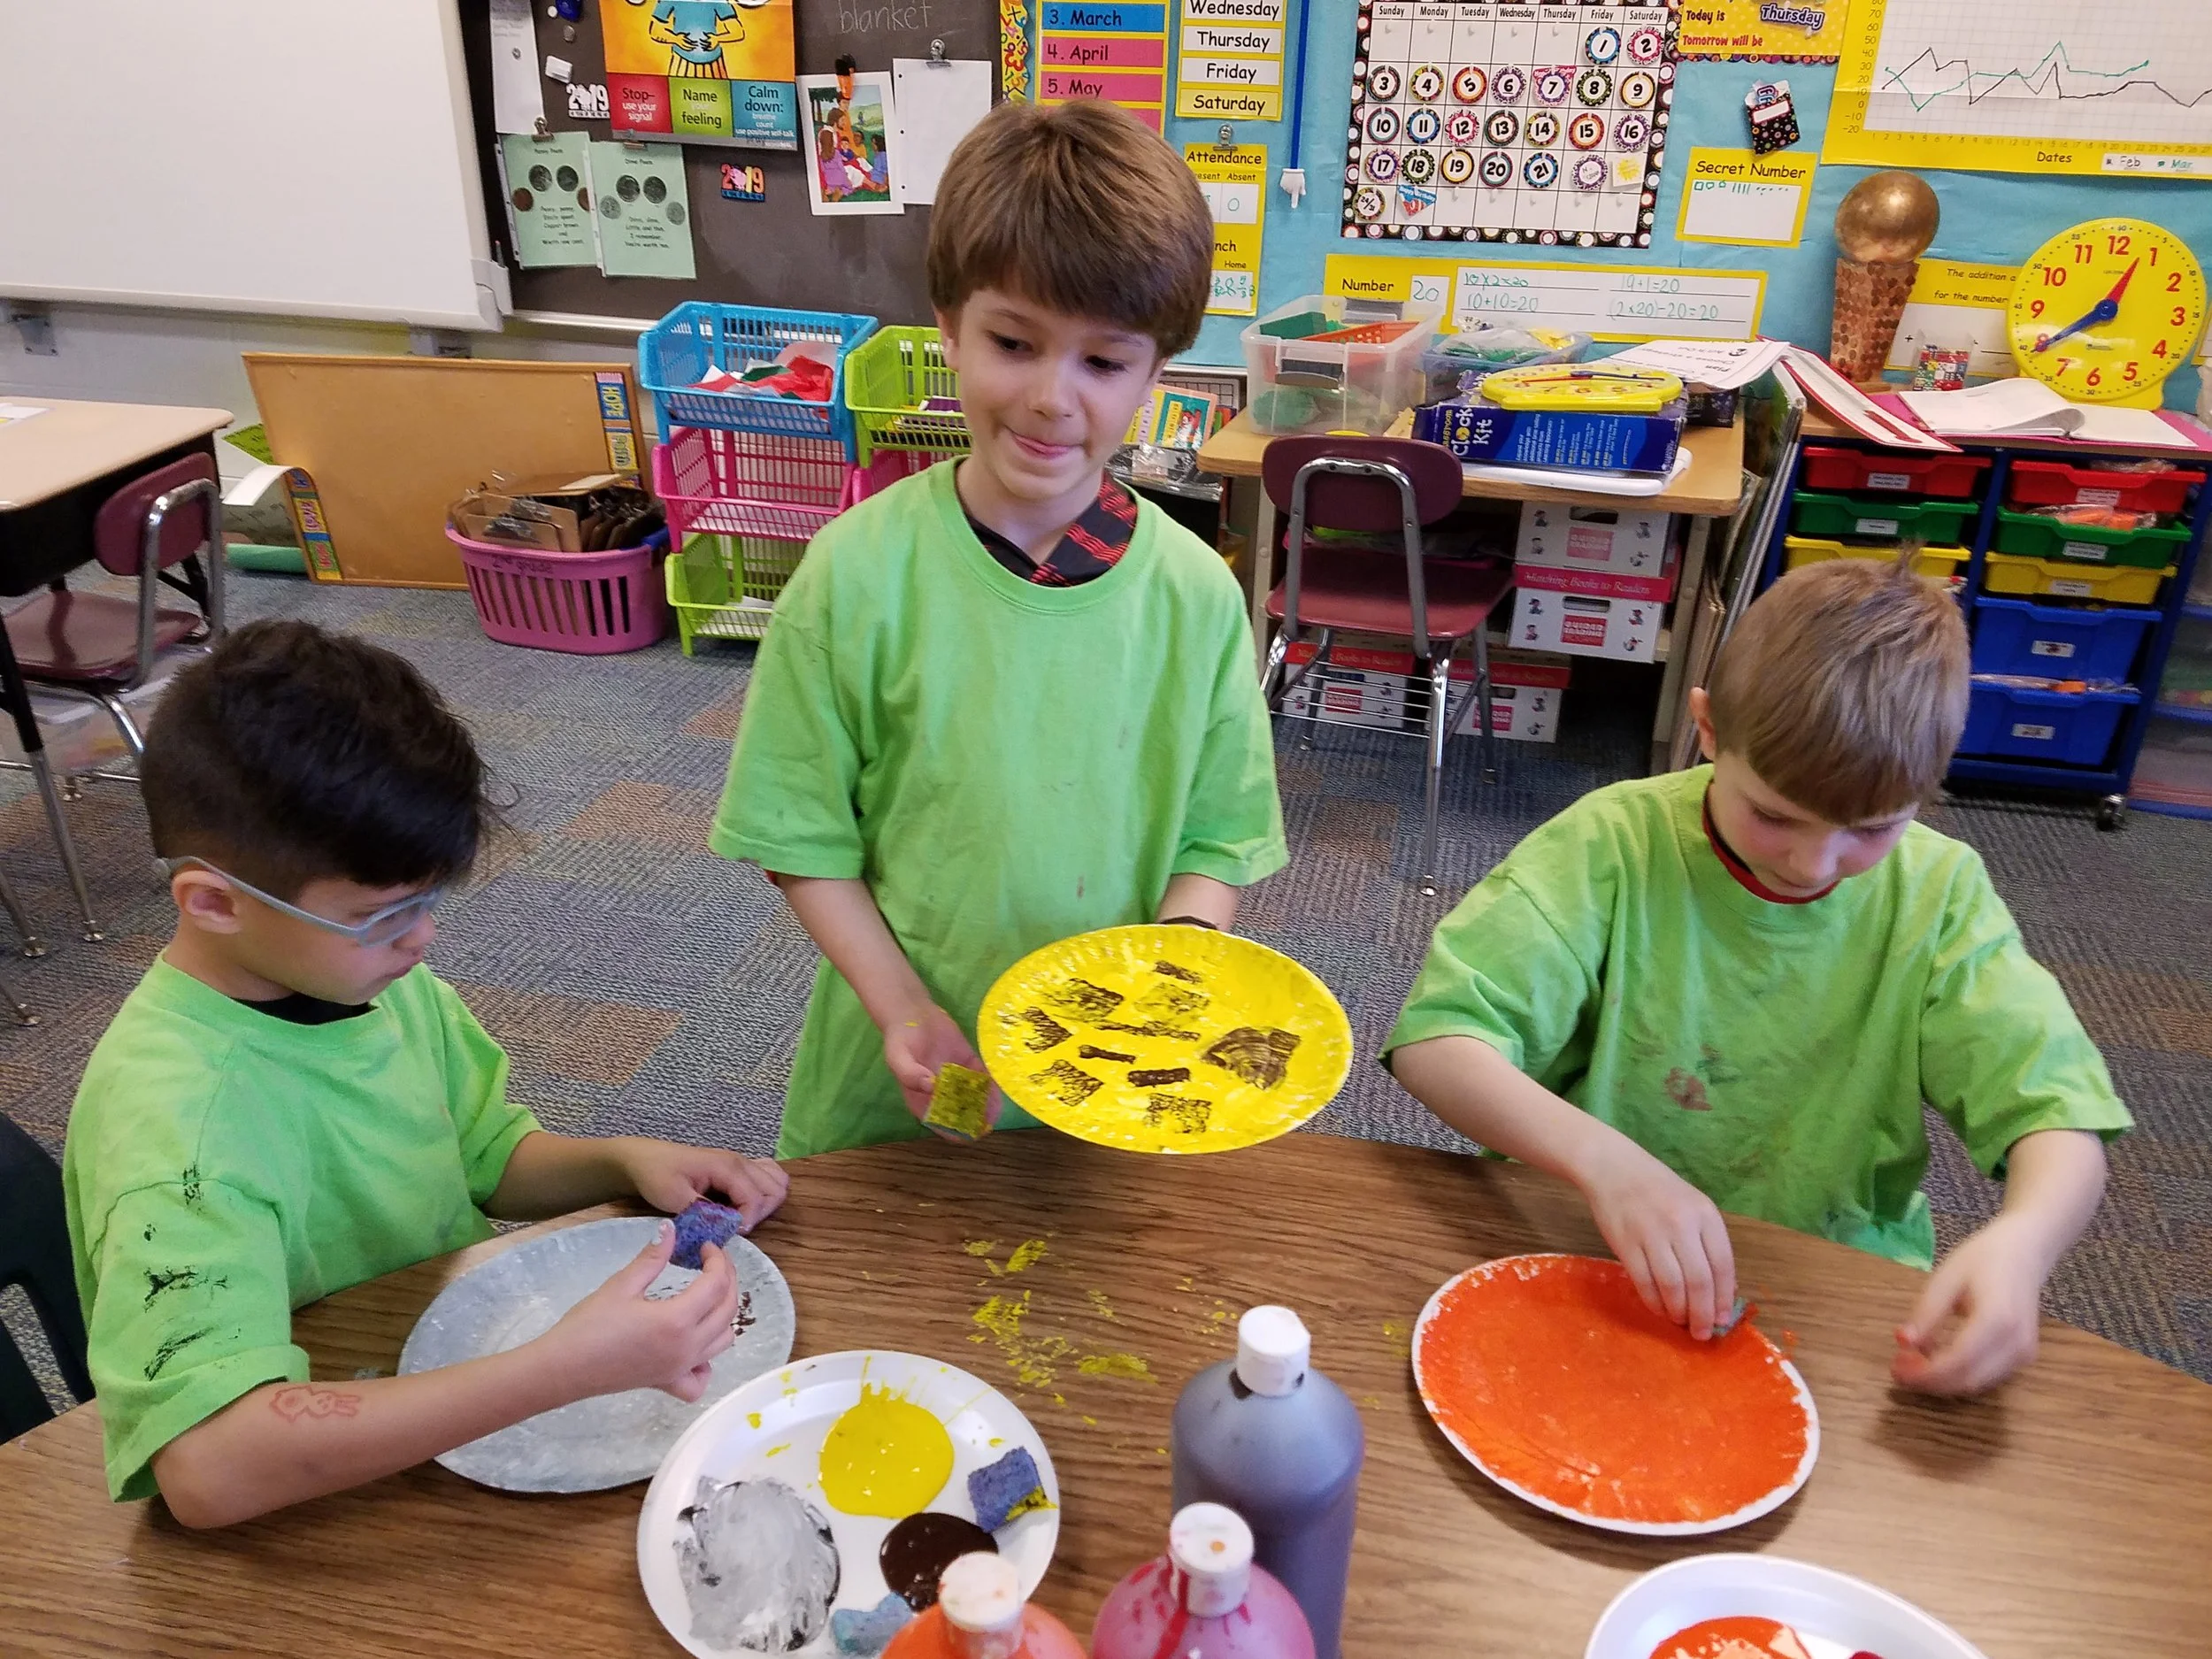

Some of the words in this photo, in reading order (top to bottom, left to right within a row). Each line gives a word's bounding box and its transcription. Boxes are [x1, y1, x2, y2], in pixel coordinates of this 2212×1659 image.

[836, 0, 933, 34] blanket
[1190, 0, 1279, 21] Wednesday
[1379, 6, 1405, 18] Sunday
[1419, 6, 1449, 19] Monday
[1461, 7, 1490, 19] Tuesday
[1499, 8, 1535, 20] Wednesday
[1543, 8, 1578, 21] Thursday
[1590, 9, 1614, 22] Friday
[1629, 10, 1663, 23] Saturday
[1686, 9, 1713, 25] Today
[1716, 10, 1724, 21] is
[1761, 4, 1825, 30] Thursday
[1048, 9, 1065, 27] 3.
[1070, 10, 1122, 27] March
[1866, 22, 1879, 31] 60
[1197, 31, 1271, 53] Thursday
[1599, 40, 1609, 53] 1
[1640, 38, 1652, 53] 2
[1682, 35, 1728, 46] Tomorrow
[1732, 35, 1749, 46] will
[1752, 35, 1763, 46] be
[1864, 35, 1877, 44] 50
[1047, 44, 1065, 61] 4.
[1069, 45, 1109, 65] April
[1862, 49, 1874, 58] 40
[1206, 64, 1257, 85] Friday
[1048, 78, 1064, 95] 5.
[1069, 79, 1102, 99] May
[1379, 76, 1389, 91] 3
[1421, 79, 1432, 92] 4
[1464, 78, 1477, 92] 5
[1503, 78, 1514, 92] 6
[1548, 81, 1558, 95] 7
[1589, 81, 1600, 95] 8
[1632, 83, 1643, 97] 9
[683, 88, 718, 102] Name
[749, 85, 779, 98] Calm
[744, 98, 784, 112] down:
[1193, 95, 1266, 117] Saturday
[628, 111, 653, 122] signal
[681, 111, 722, 128] feeling
[1376, 119, 1391, 133] 10
[1418, 120, 1428, 134] 11
[1456, 121, 1470, 135] 12
[1495, 121, 1509, 134] 13
[1535, 122, 1550, 136] 14
[1580, 123, 1594, 137] 15
[1624, 124, 1639, 139] 16
[1187, 151, 1262, 165] Attendance
[2037, 151, 2072, 163] Dates
[2120, 156, 2141, 168] Feb
[1377, 159, 1391, 173] 17
[1411, 160, 1425, 173] 18
[1450, 159, 1464, 173] 19
[1486, 162, 1505, 177] 20
[1534, 163, 1549, 178] 21
[1695, 160, 1746, 175] Secret
[1750, 163, 1806, 179] Number
[1226, 173, 1256, 181] Absent
[1215, 240, 1237, 252] nch
[2108, 234, 2131, 256] 12
[2074, 243, 2093, 265] 11
[2149, 247, 2158, 266] 1
[1947, 268, 1964, 278] The
[1968, 270, 2007, 281] addition
[2042, 266, 2068, 287] 10
[2165, 272, 2182, 293] 2
[1341, 278, 1394, 292] Number
[1413, 280, 1440, 302] 20
[1934, 289, 1949, 299] for
[1953, 291, 1969, 301] the
[2030, 299, 2046, 319] 9
[2170, 305, 2186, 326] 3
[2151, 339, 2168, 359] 4
[2055, 357, 2071, 377] 7
[2122, 361, 2139, 381] 5
[2085, 366, 2101, 387] 6
[602, 386, 625, 418] HOPE
[1443, 409, 1454, 448] assroom
[1451, 408, 1475, 456] Clock
[1472, 419, 1494, 445] Kit
[1524, 572, 1569, 588] Matching
[1570, 577, 1600, 590] Books
[1613, 581, 1651, 595] Readers
